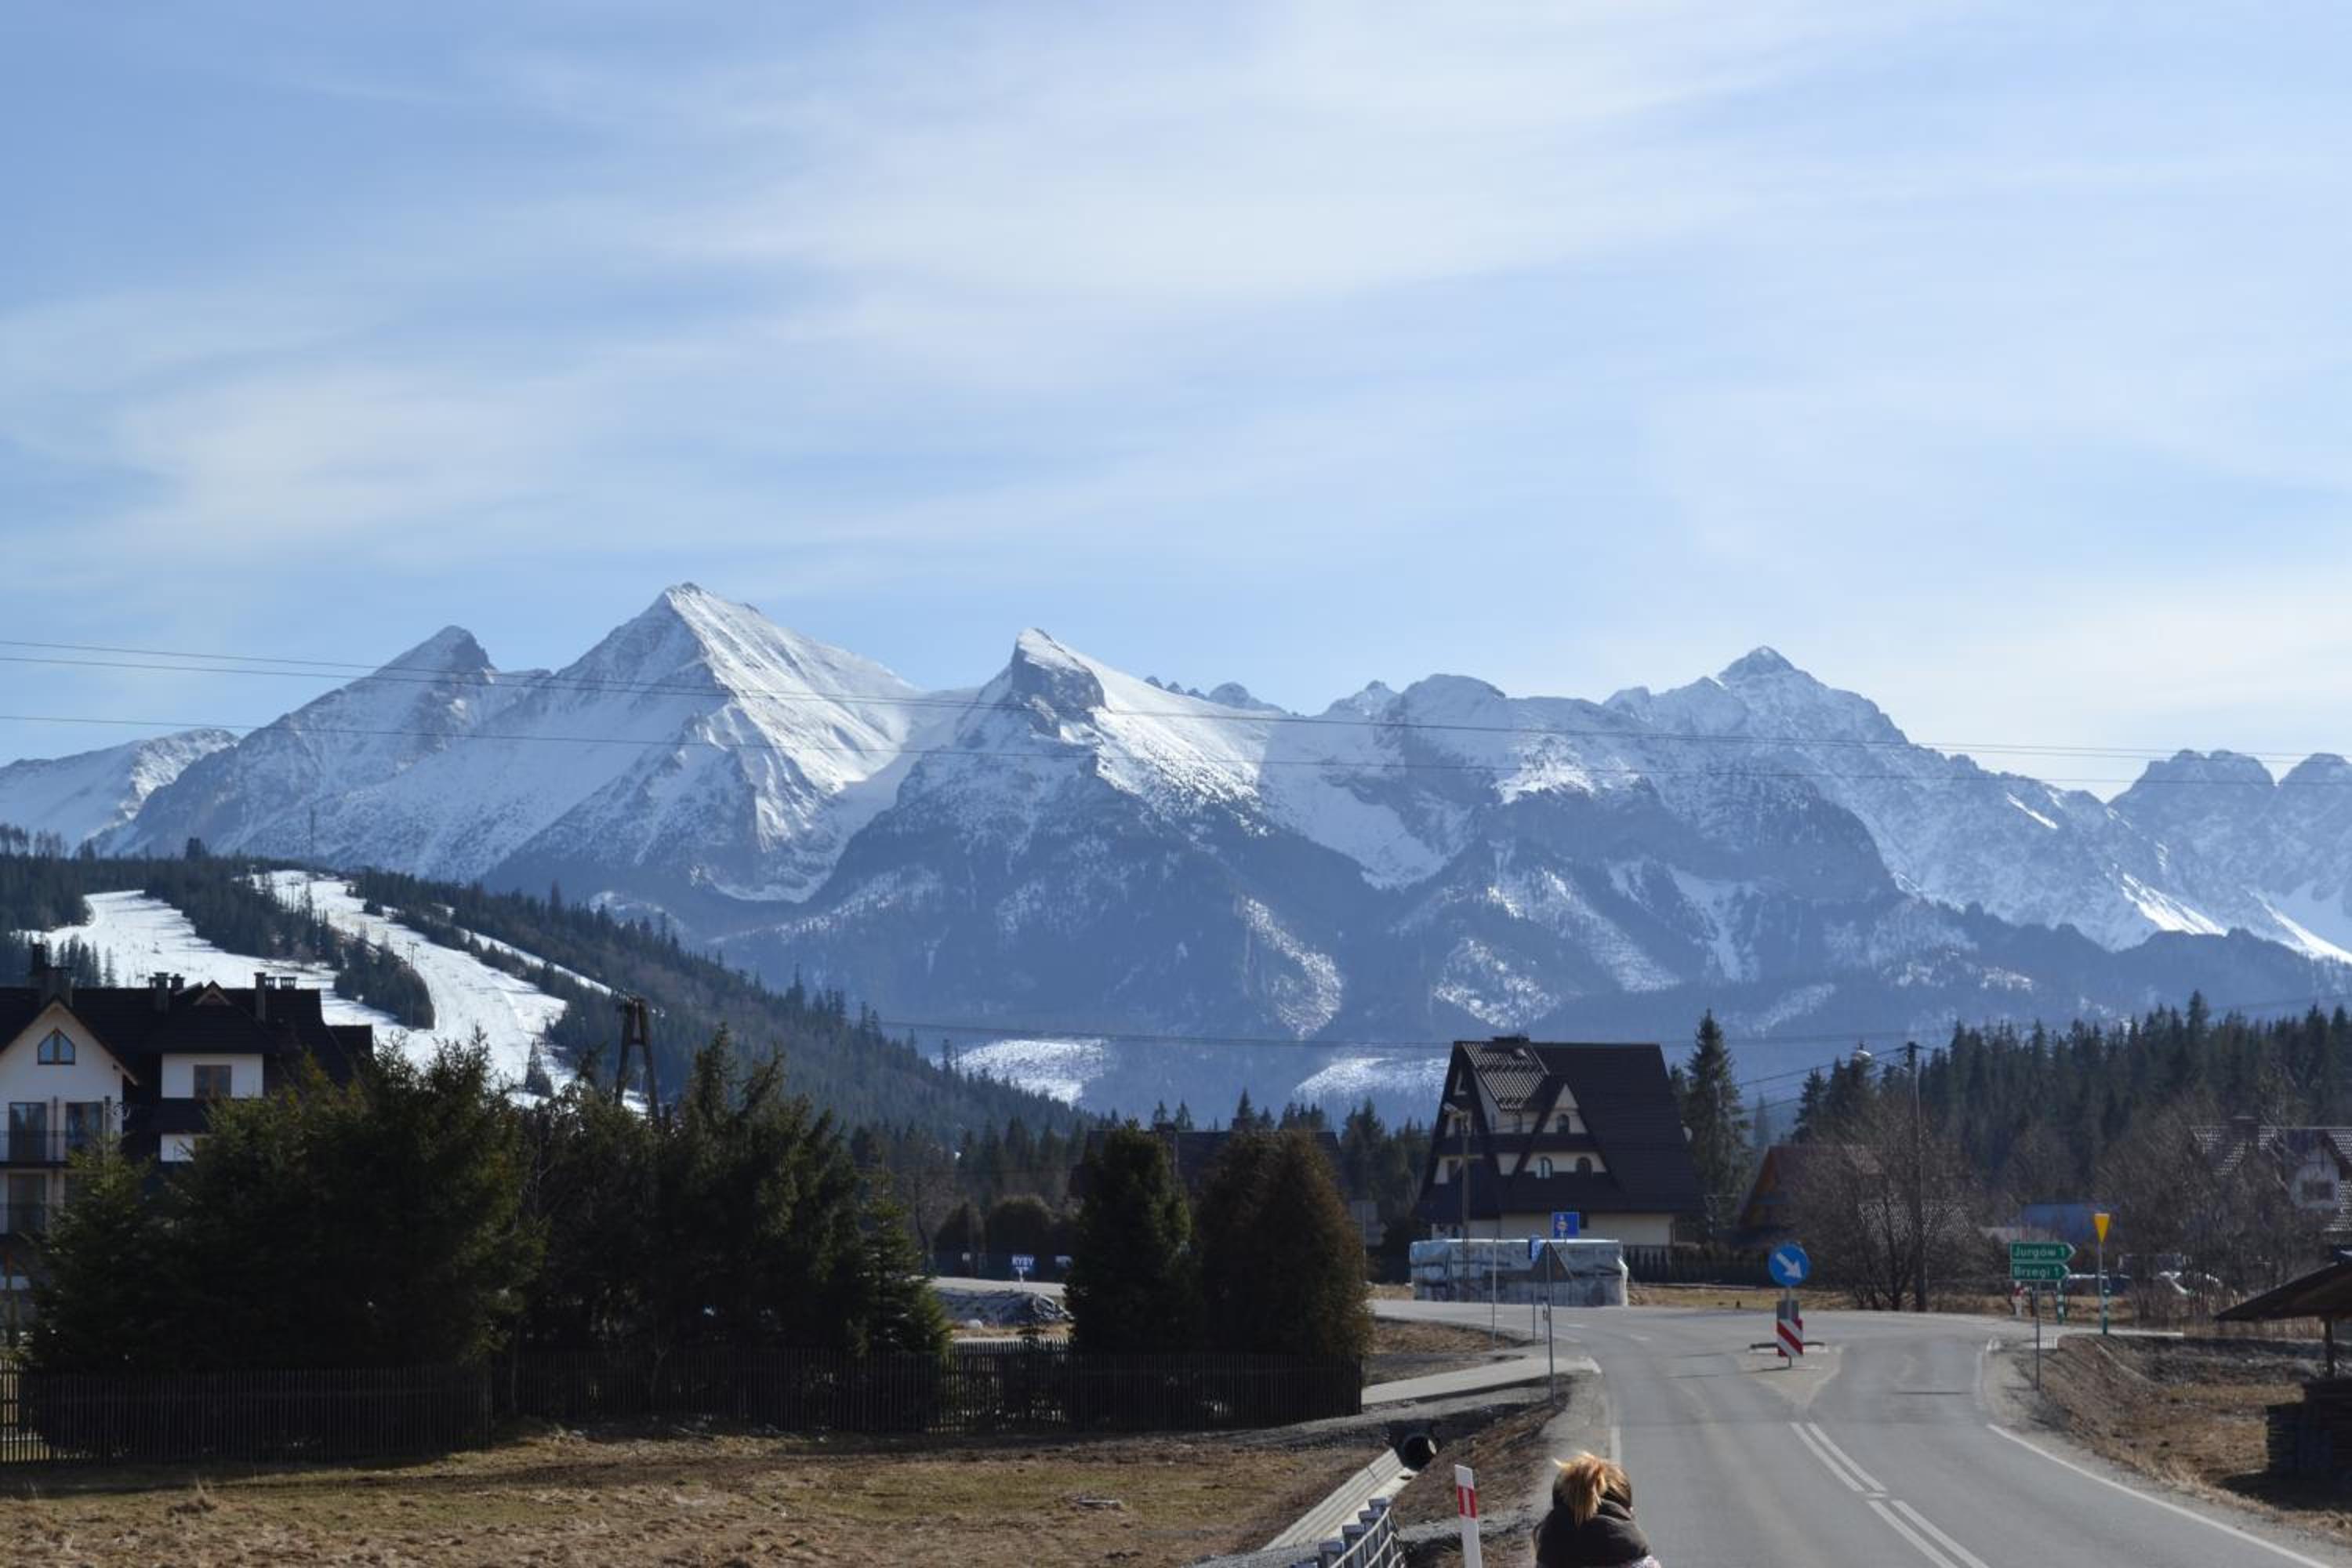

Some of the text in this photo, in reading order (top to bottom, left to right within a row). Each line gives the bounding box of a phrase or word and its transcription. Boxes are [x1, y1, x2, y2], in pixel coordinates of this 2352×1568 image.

[2014, 1246, 2064, 1260] Jurgów 1
[2014, 1266, 2059, 1279] Brzegi 1
